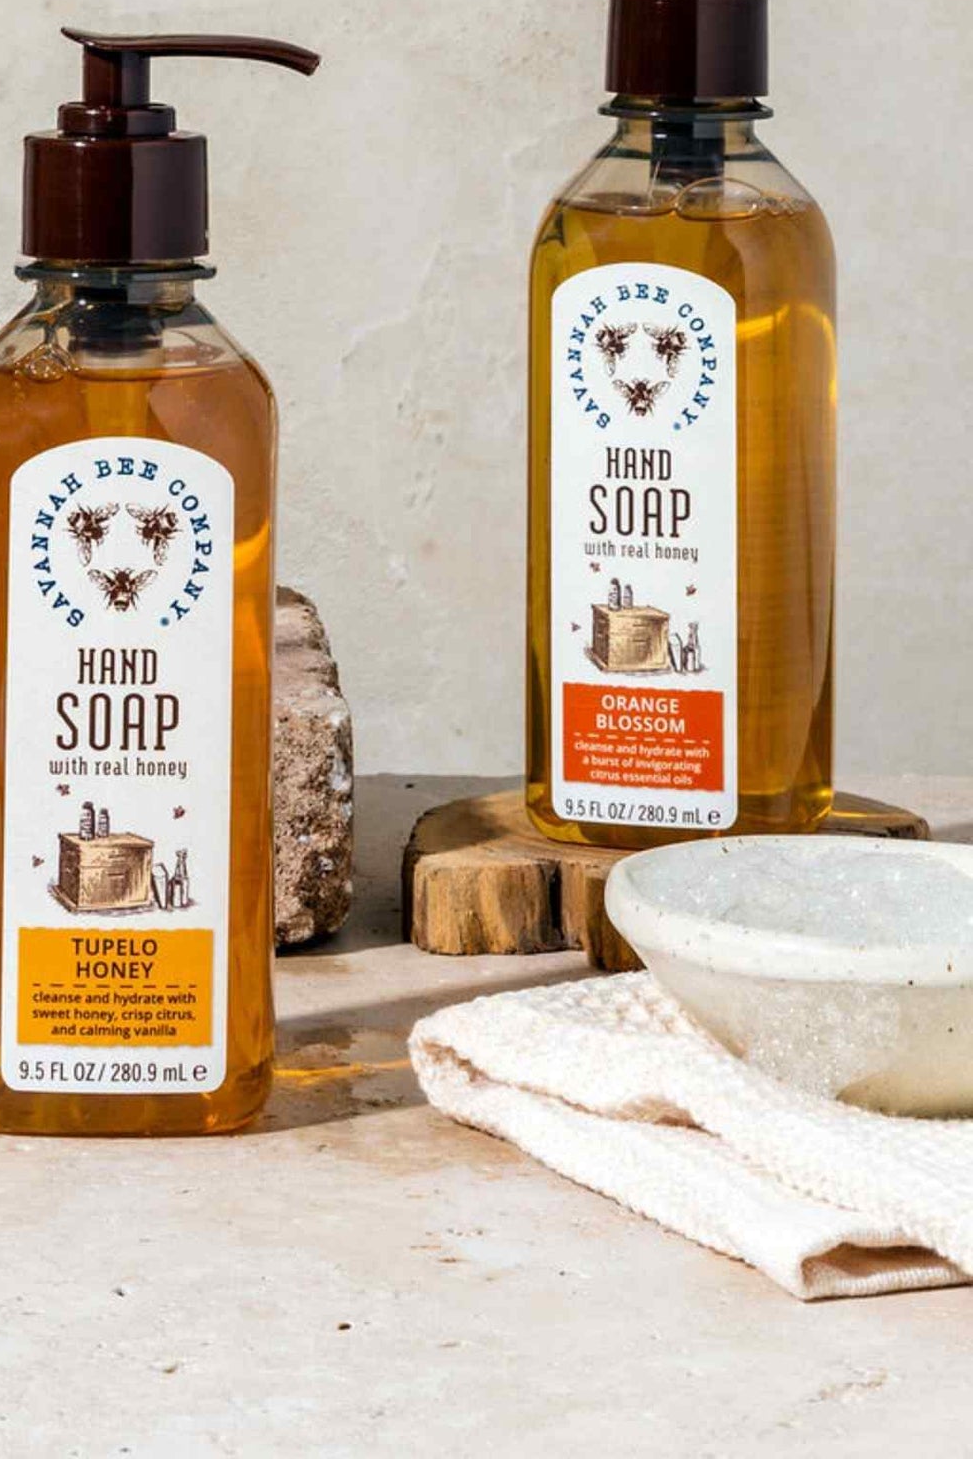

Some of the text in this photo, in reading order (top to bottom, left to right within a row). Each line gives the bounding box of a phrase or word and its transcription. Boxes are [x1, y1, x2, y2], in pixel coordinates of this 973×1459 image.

[568, 296, 611, 429] SAVANNAH
[617, 283, 670, 304] BEE
[606, 447, 672, 481] HAND
[590, 484, 691, 538] SOAP
[31, 472, 84, 627] SAVANNAH
[95, 458, 158, 481] BEE
[584, 540, 699, 562] with real honey
[78, 648, 158, 685] HAND
[601, 695, 679, 714] ORANGE
[56, 693, 179, 751] SOAP
[596, 714, 685, 733] BLOSSOM
[575, 741, 709, 757] cleanse and hydrate with
[49, 757, 187, 779] with real honey
[583, 755, 701, 774] a burst of invigorating
[590, 769, 692, 785] citrus essential oils
[565, 799, 585, 816] 9.5
[590, 801, 603, 818] FL
[682, 808, 703, 824] mL
[71, 938, 158, 956] TUPELO
[76, 961, 155, 979] HONEY
[33, 991, 196, 1007] cleanse and hydrate with
[32, 1008, 196, 1023] sweet honey, crisp citrus,
[51, 1024, 177, 1040] and calming vanilla
[19, 1060, 44, 1080] 9.5
[50, 1062, 67, 1081] FL
[163, 1063, 187, 1082] mL
